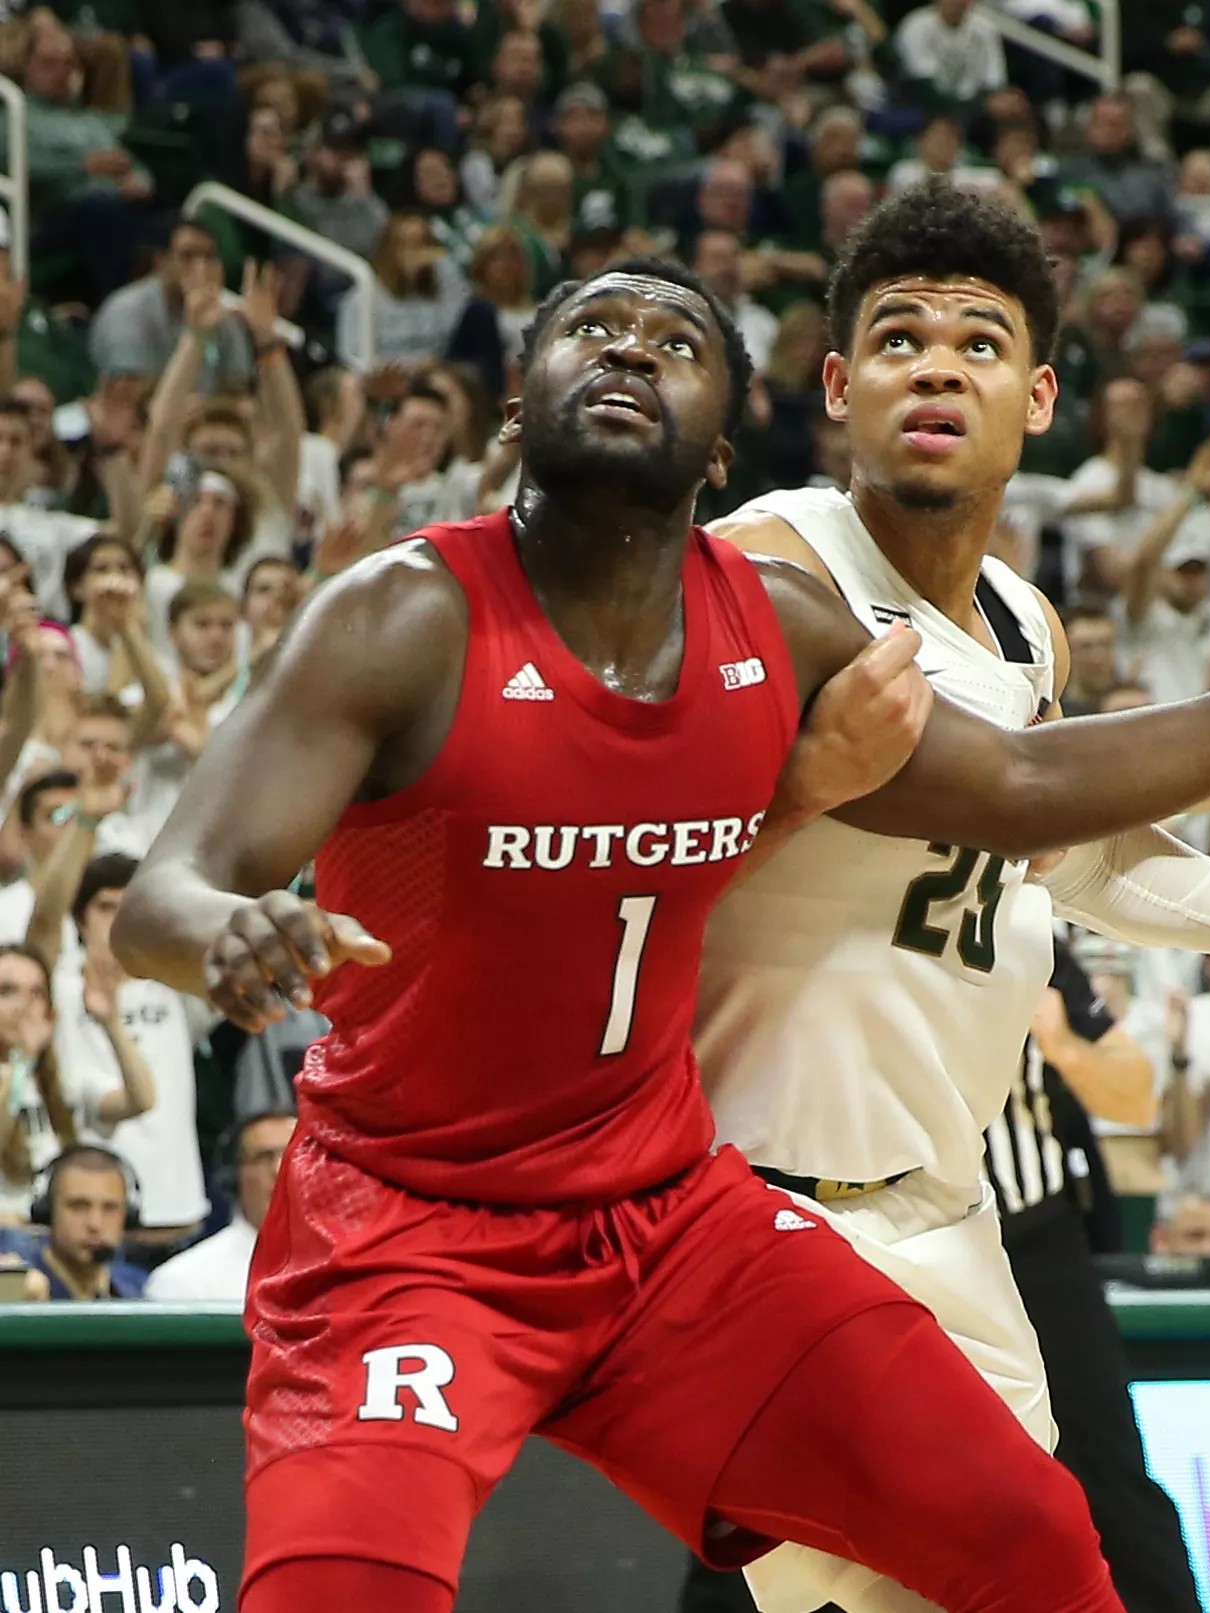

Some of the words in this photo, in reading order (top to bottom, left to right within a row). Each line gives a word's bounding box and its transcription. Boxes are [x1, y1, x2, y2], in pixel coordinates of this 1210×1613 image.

[501, 687, 554, 700] adidas
[600, 896, 656, 1055] 1
[357, 1343, 460, 1433] R
